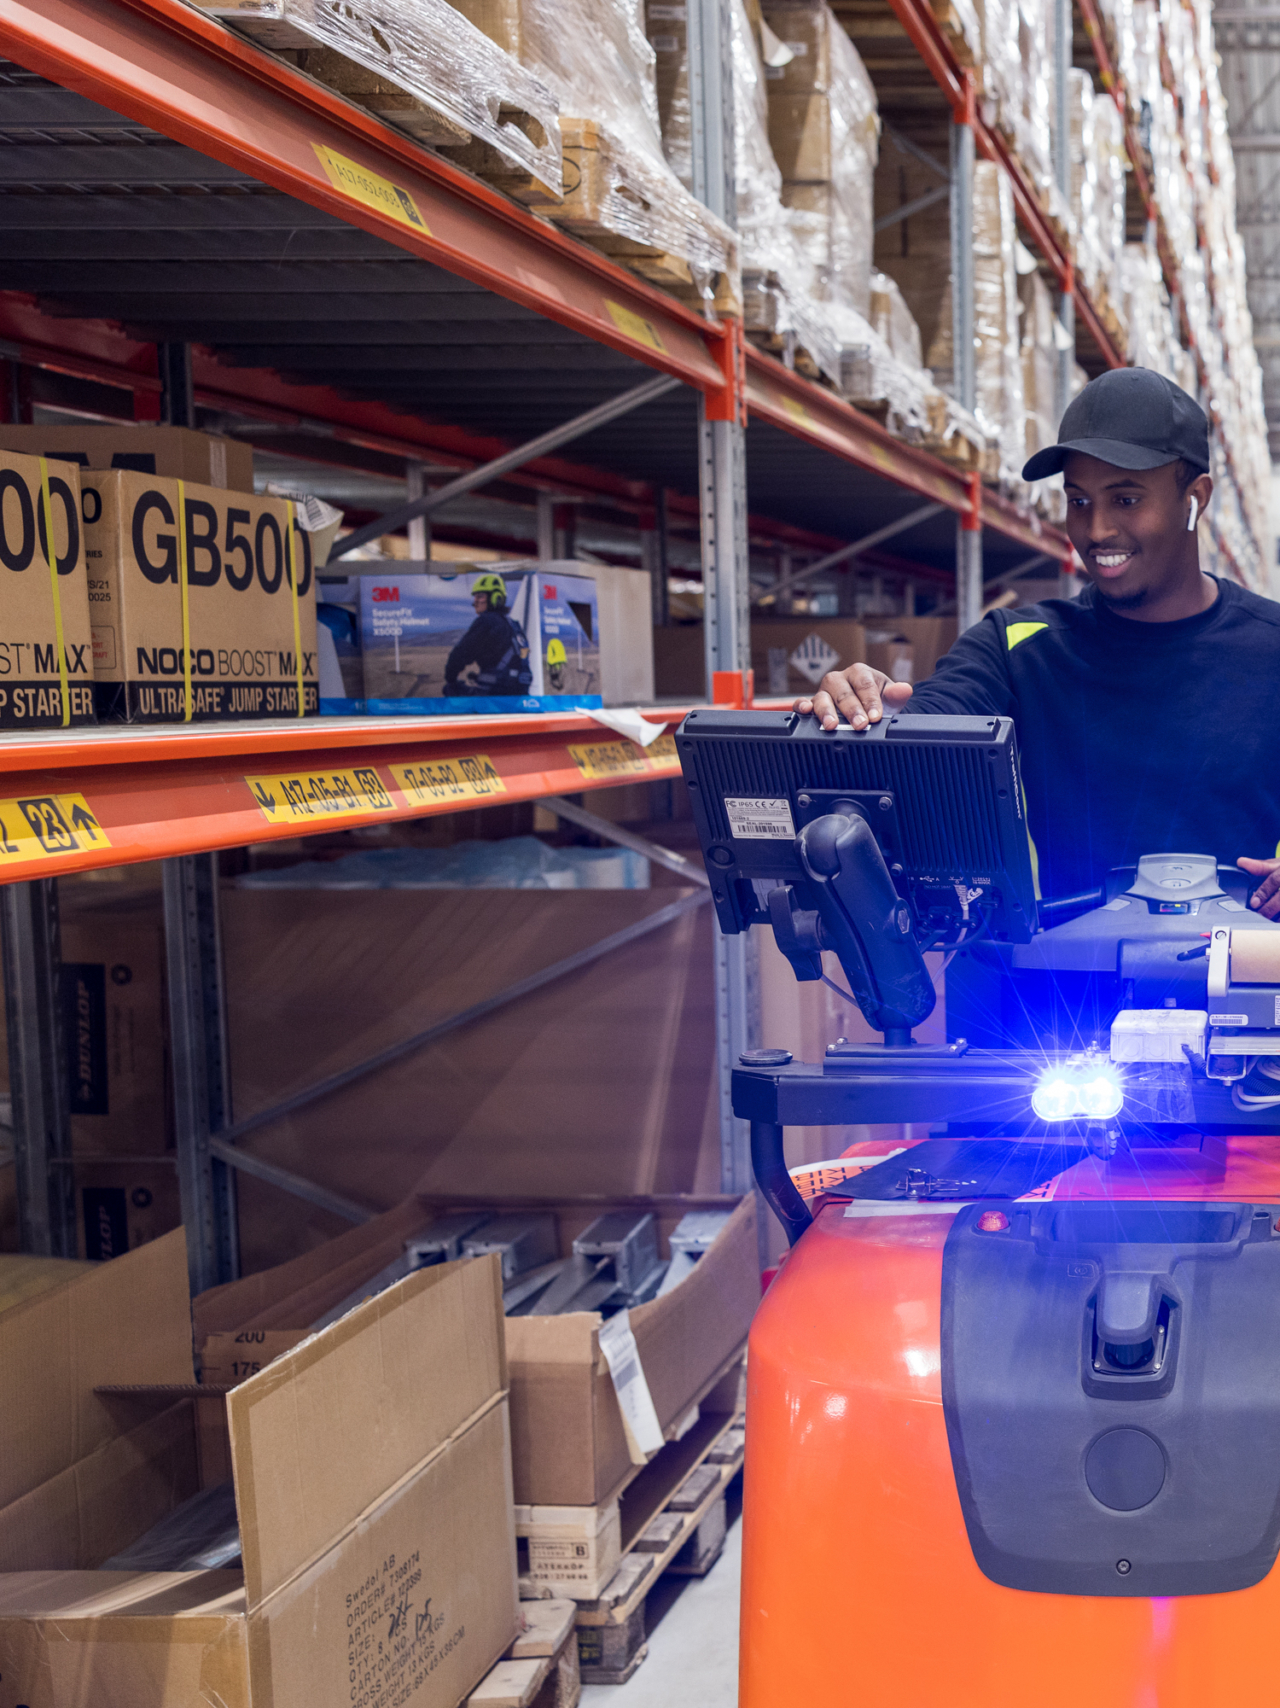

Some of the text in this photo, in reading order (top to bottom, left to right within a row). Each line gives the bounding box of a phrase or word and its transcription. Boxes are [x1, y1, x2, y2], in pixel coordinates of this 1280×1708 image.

[132, 490, 312, 597] GB500
[372, 586, 400, 603] 3M
[136, 647, 215, 675] NOCO
[13, 687, 93, 718] STARTER
[229, 687, 263, 713] JUMP
[266, 686, 318, 712] STARTER
[280, 775, 356, 815] A17-05-B1
[404, 765, 464, 799] 17-05-B2
[26, 802, 72, 849] 23
[78, 979, 92, 1083] DUNLOP
[100, 1205, 112, 1260] LOP
[235, 1331, 265, 1344] 200
[232, 1362, 260, 1376] 175
[576, 1546, 585, 1556] B
[346, 1554, 396, 1608] Swedol AB
[349, 1634, 375, 1666] SIZE:
[384, 1643, 416, 1685] WEIGHT
[350, 1653, 374, 1683] QTY:
[351, 1651, 391, 1700] CARTON
